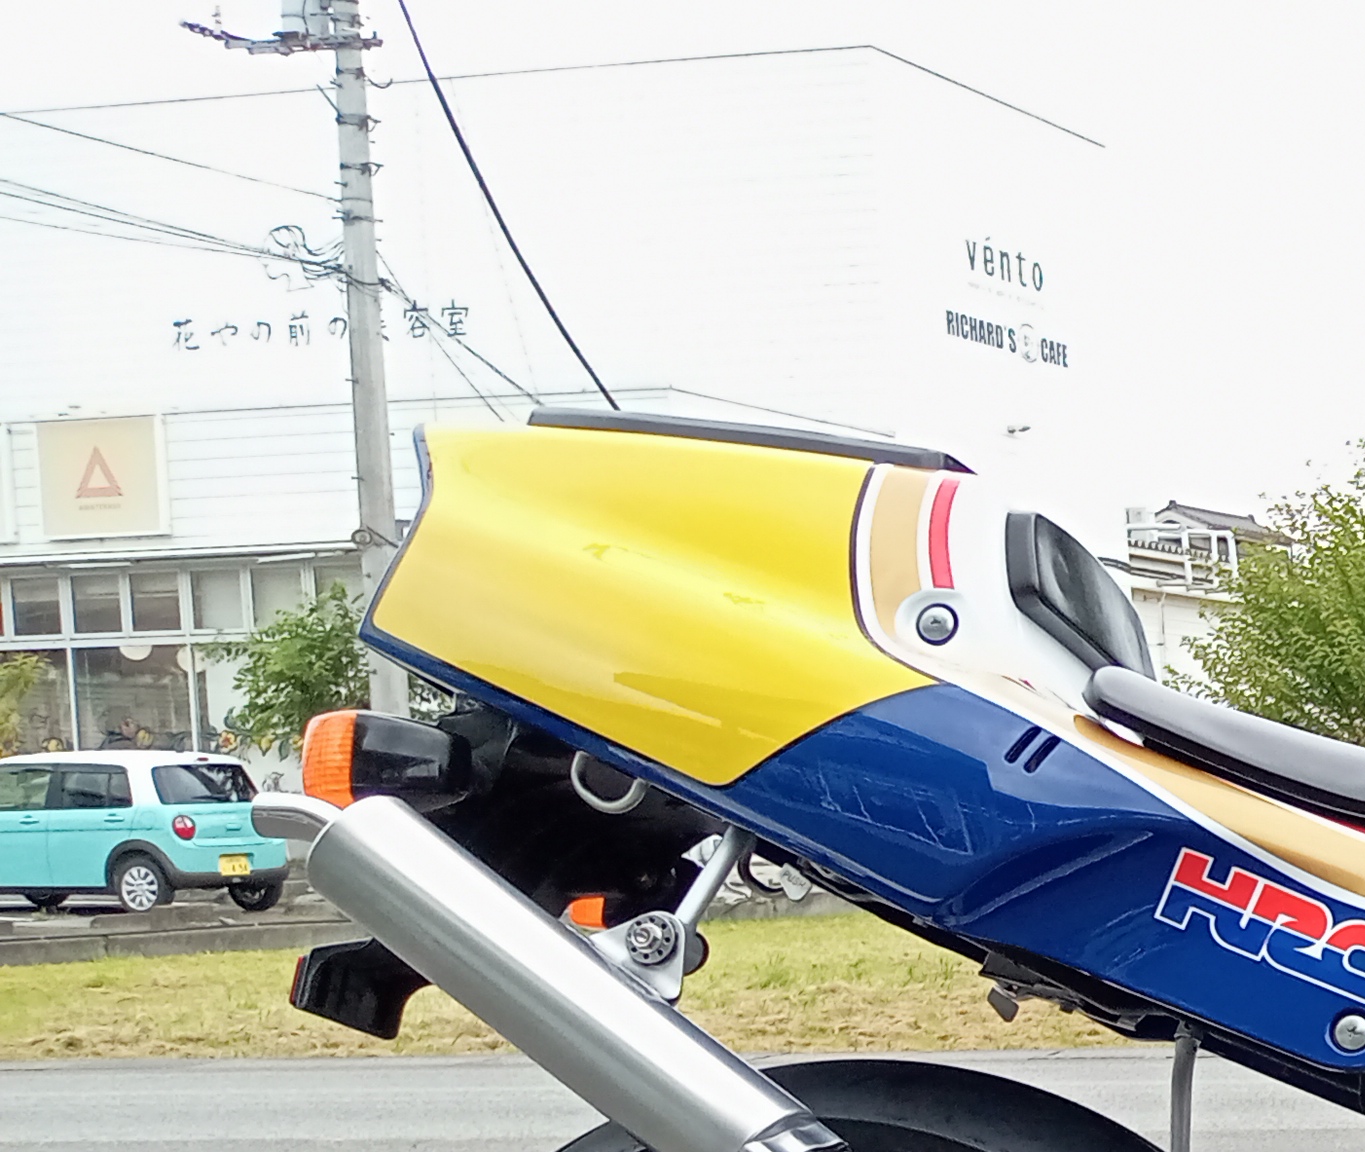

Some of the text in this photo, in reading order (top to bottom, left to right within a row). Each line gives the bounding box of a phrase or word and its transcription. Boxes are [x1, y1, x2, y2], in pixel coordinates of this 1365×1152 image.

[173, 300, 469, 350] 花やの前の容室
[946, 309, 1068, 368] RICHARD'S CAFE
